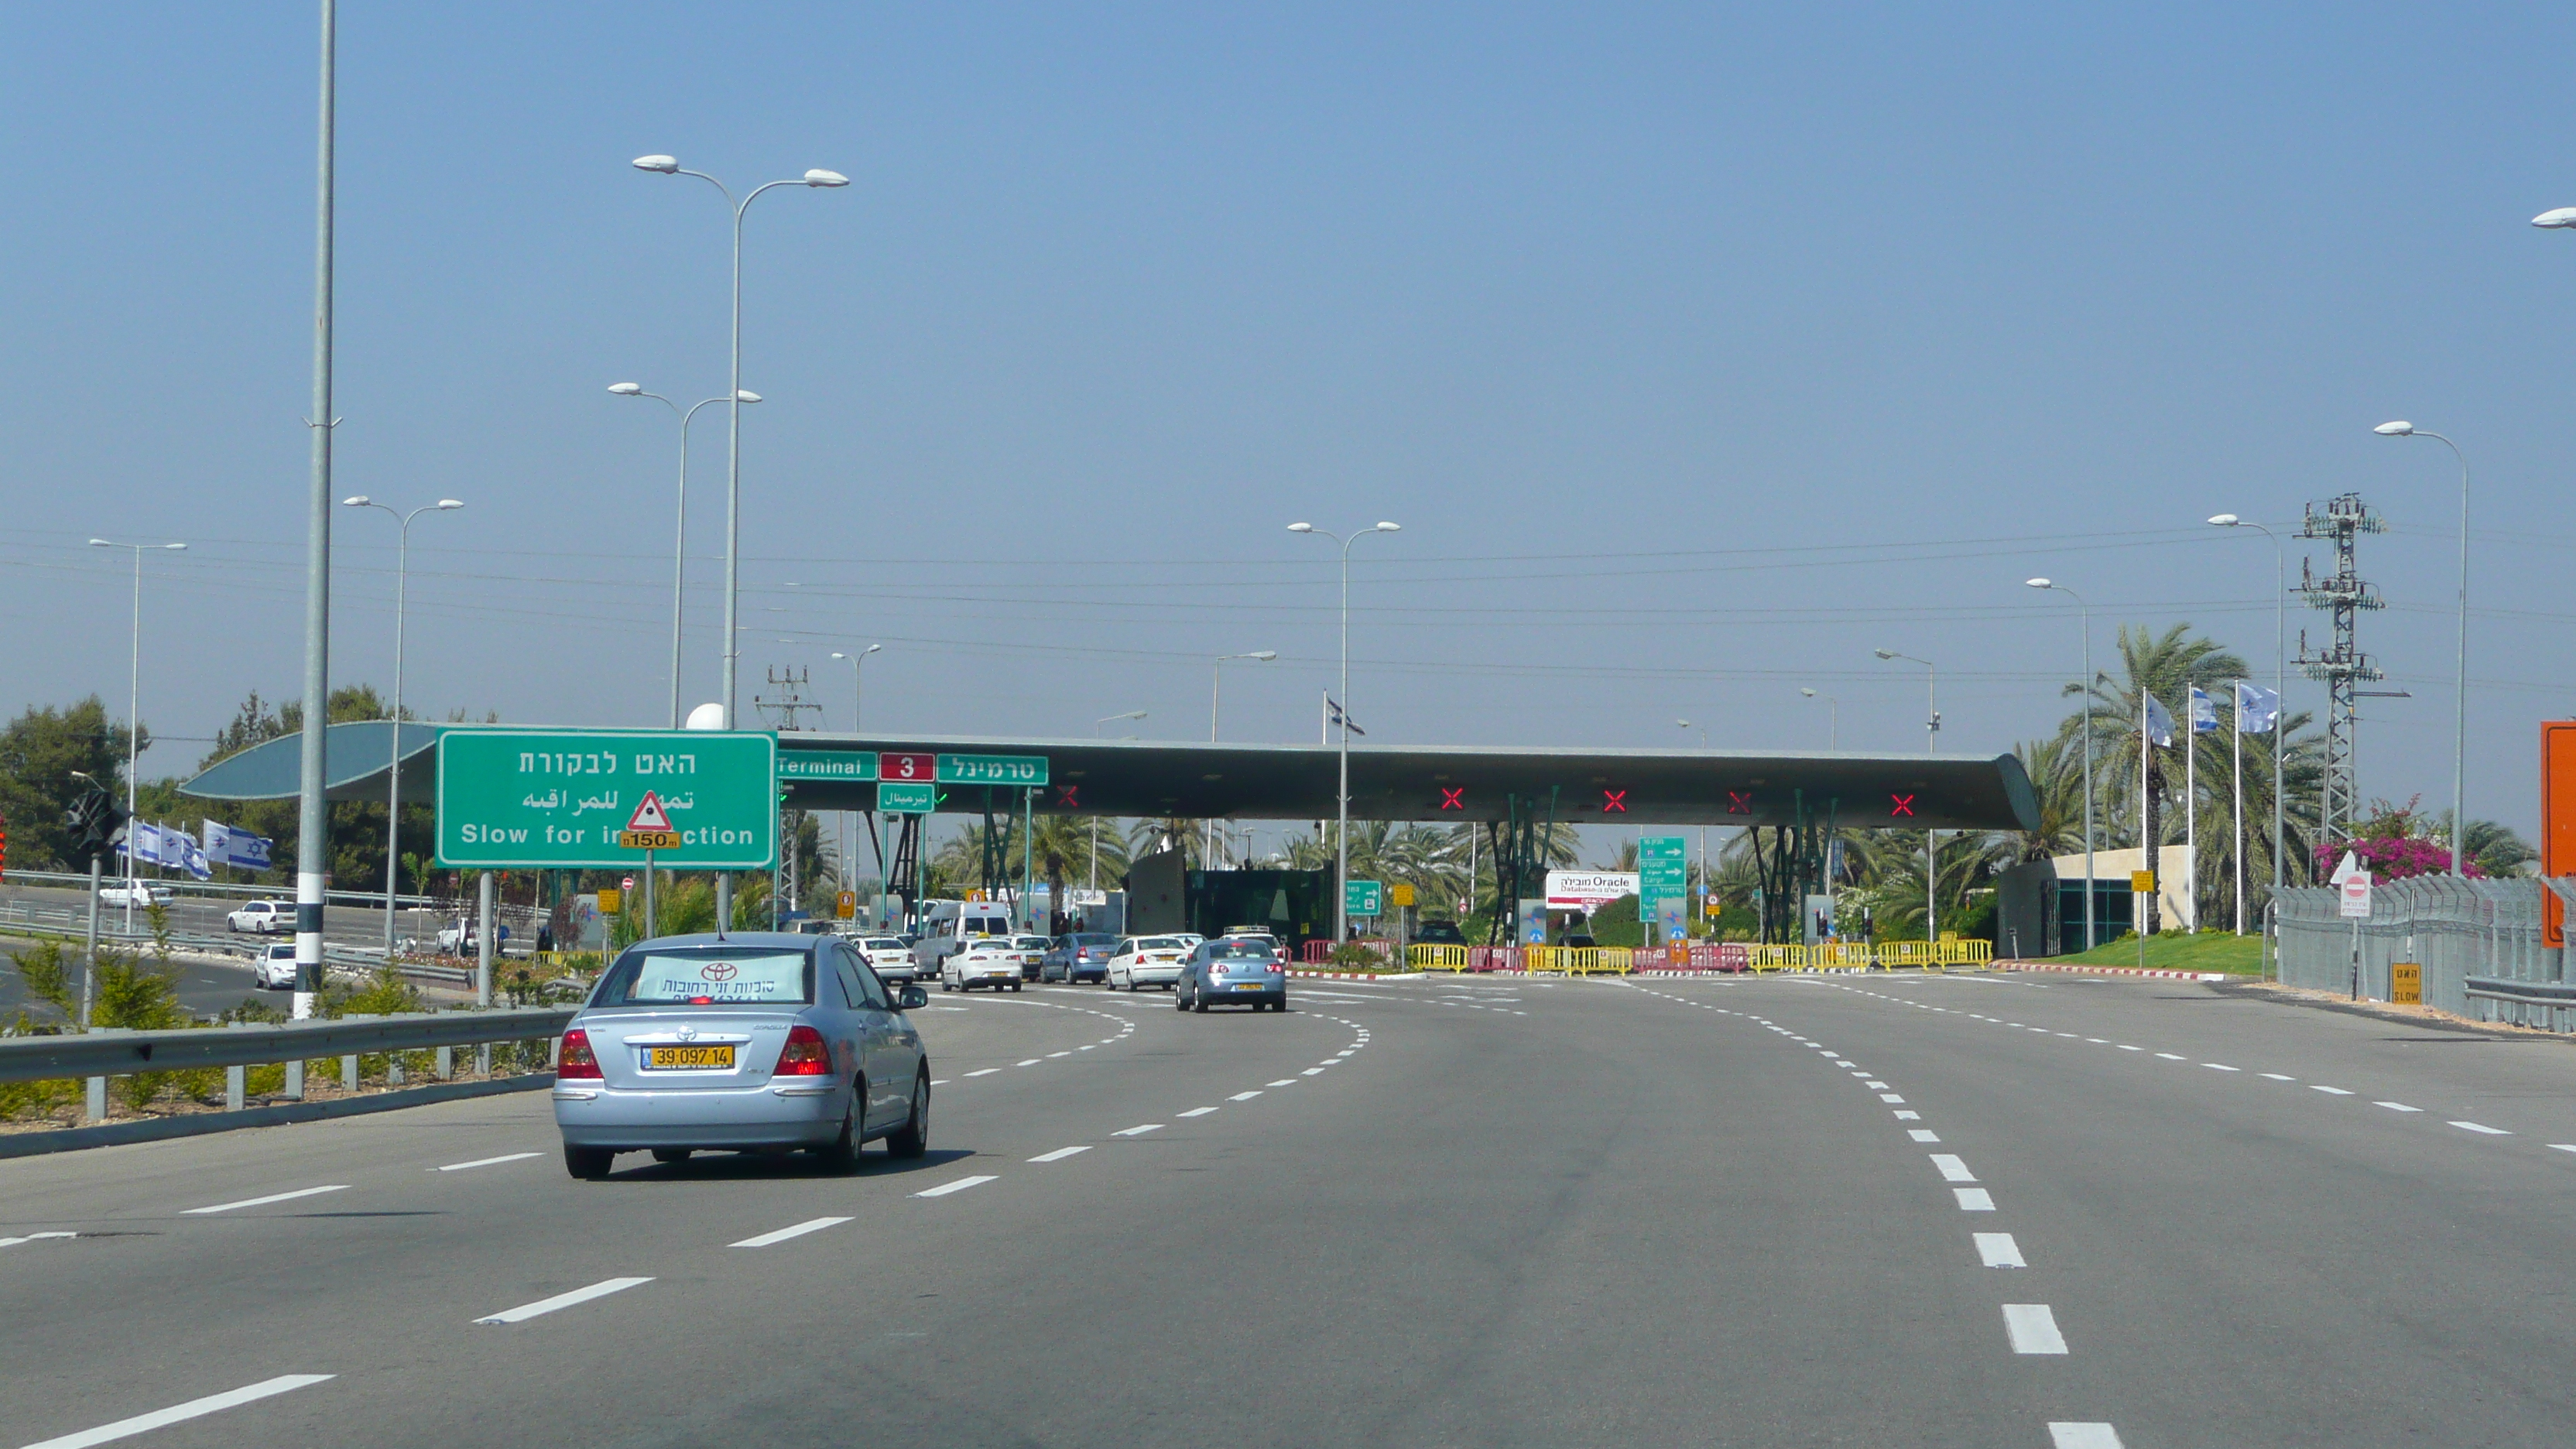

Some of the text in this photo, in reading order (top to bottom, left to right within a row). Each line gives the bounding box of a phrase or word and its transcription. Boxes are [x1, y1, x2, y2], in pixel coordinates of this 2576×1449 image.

[519, 751, 695, 776] האט לבקורת
[777, 757, 861, 774] Terminal
[900, 757, 914, 777] 3
[952, 757, 1035, 779] טרמינל
[461, 824, 529, 843] Slow
[546, 825, 585, 844] for
[631, 834, 667, 846] 150
[1594, 876, 1629, 886] Oracle
[2396, 969, 2417, 978] האט
[663, 979, 709, 993] רחובות
[2394, 992, 2419, 1001] SLOW
